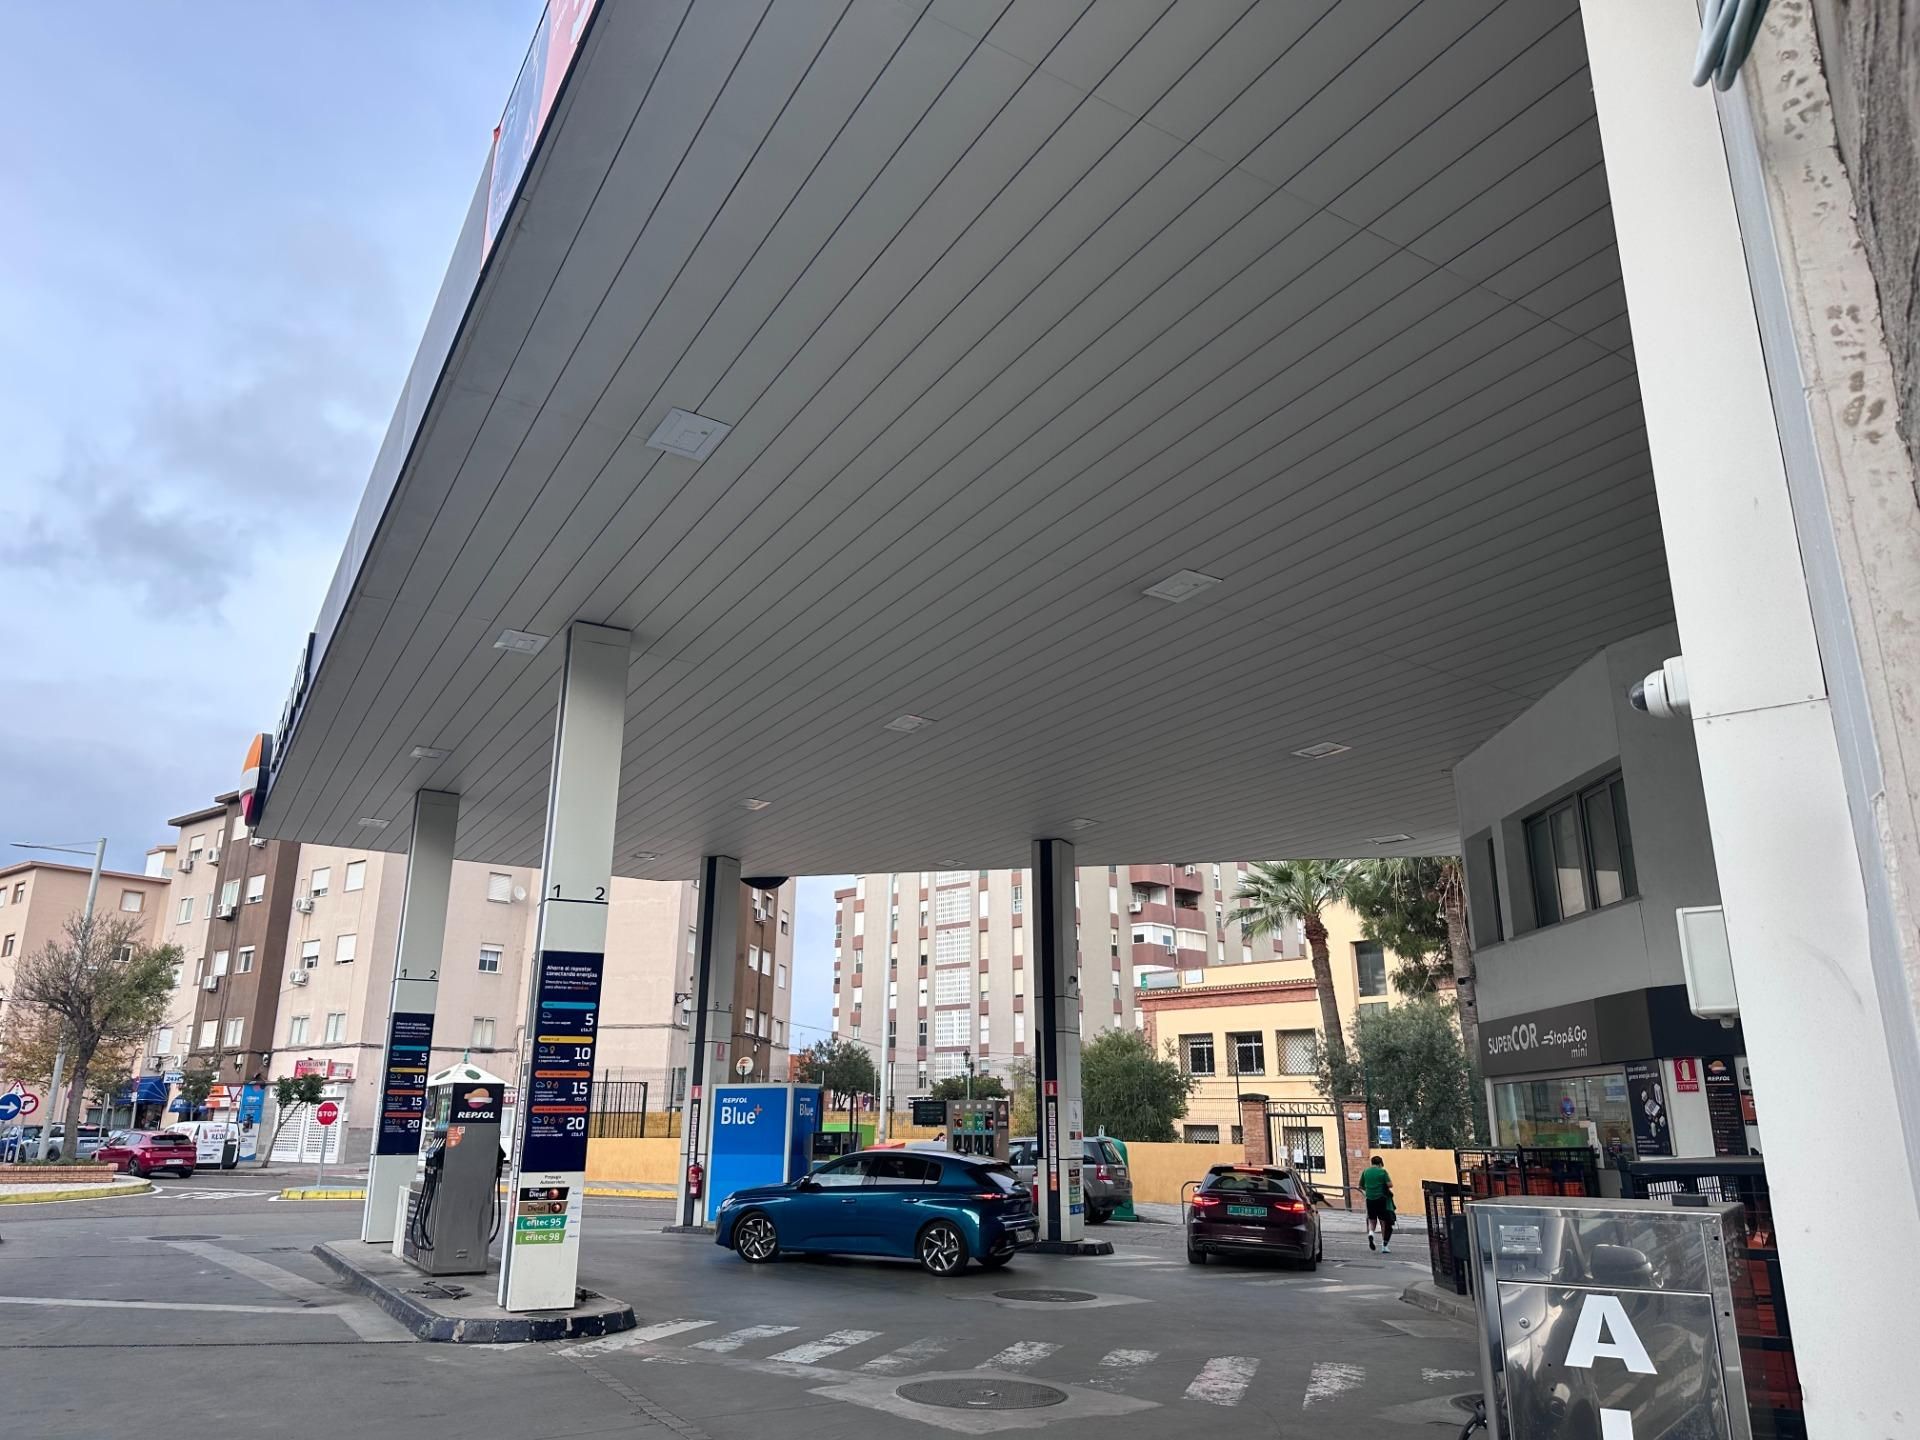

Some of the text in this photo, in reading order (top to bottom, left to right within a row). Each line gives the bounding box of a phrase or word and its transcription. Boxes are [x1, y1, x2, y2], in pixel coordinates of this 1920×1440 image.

[553, 884, 605, 900] 1 2
[402, 968, 437, 979] 1 2
[585, 1013, 594, 1026] 5
[1488, 1022, 1587, 1054] SUPERCOR Stop&Go
[574, 1047, 591, 1060] 10
[1571, 1043, 1587, 1058] mini
[420, 1053, 427, 1062] 5
[413, 1074, 425, 1084] 10
[571, 1082, 588, 1095] 15
[411, 1097, 422, 1106] 15
[1289, 1103, 1336, 1114] KURSAA
[407, 1120, 420, 1129] 20
[566, 1117, 585, 1130] 20
